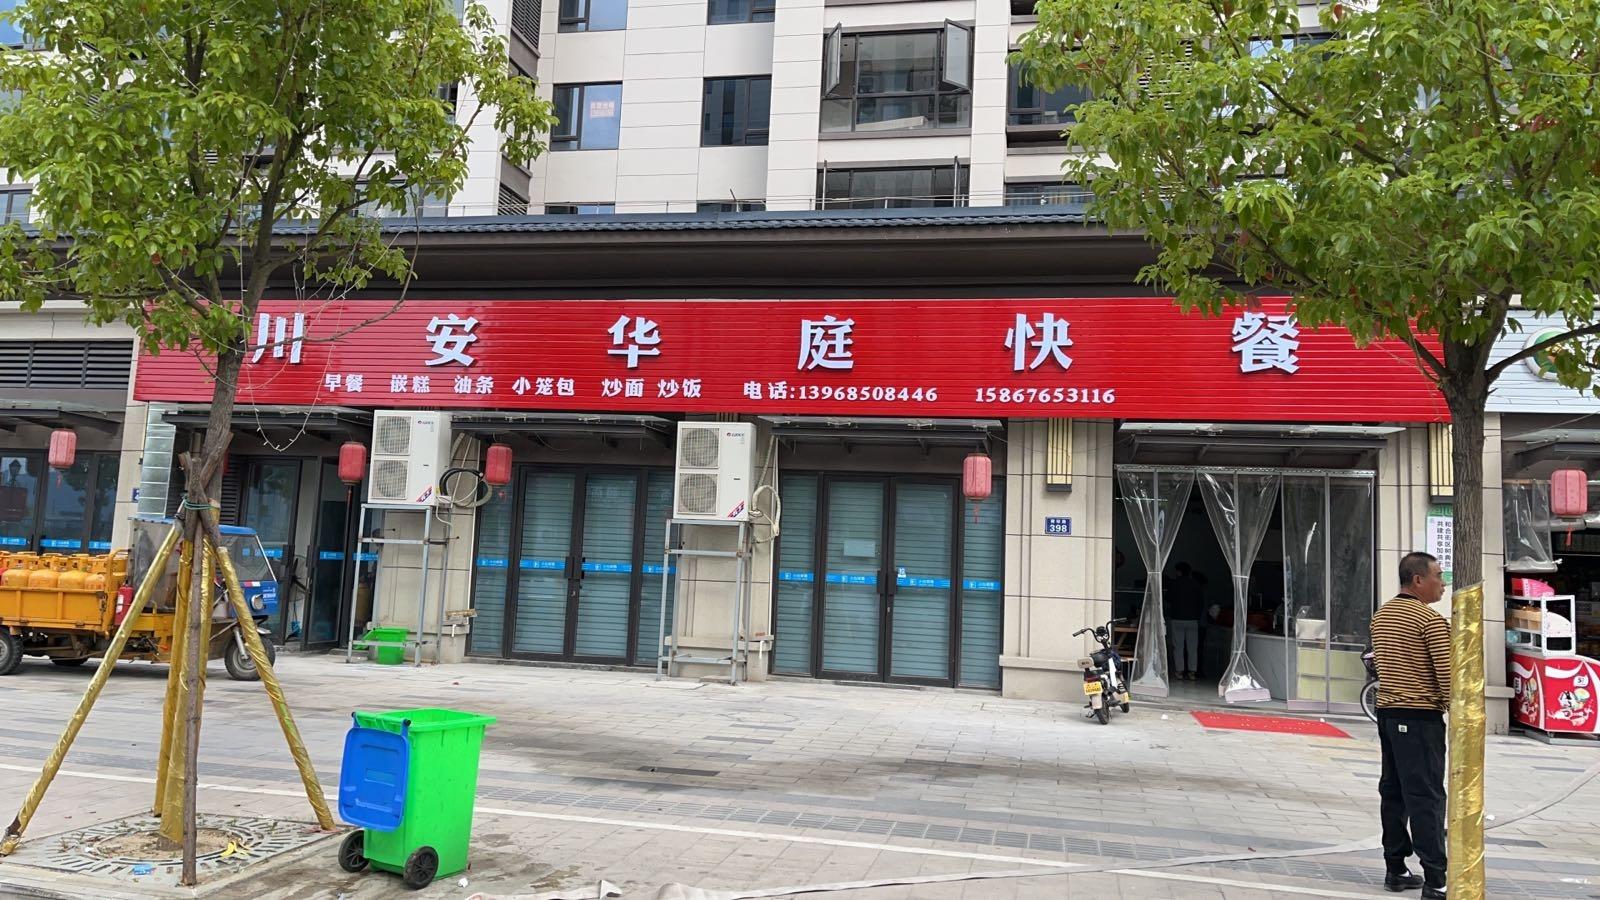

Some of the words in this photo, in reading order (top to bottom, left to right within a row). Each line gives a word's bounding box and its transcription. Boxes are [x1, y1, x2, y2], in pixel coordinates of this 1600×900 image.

[251, 312, 1300, 374] 川安华庭快餐
[323, 373, 364, 393] 早餐
[390, 373, 431, 394] 嵌糕
[453, 374, 494, 394] 油条
[511, 376, 575, 396] 小笼包
[601, 378, 645, 398] 炒面
[657, 378, 702, 398] 炒饭
[975, 387, 1115, 404] 15867653116
[1049, 524, 1067, 532] 398
